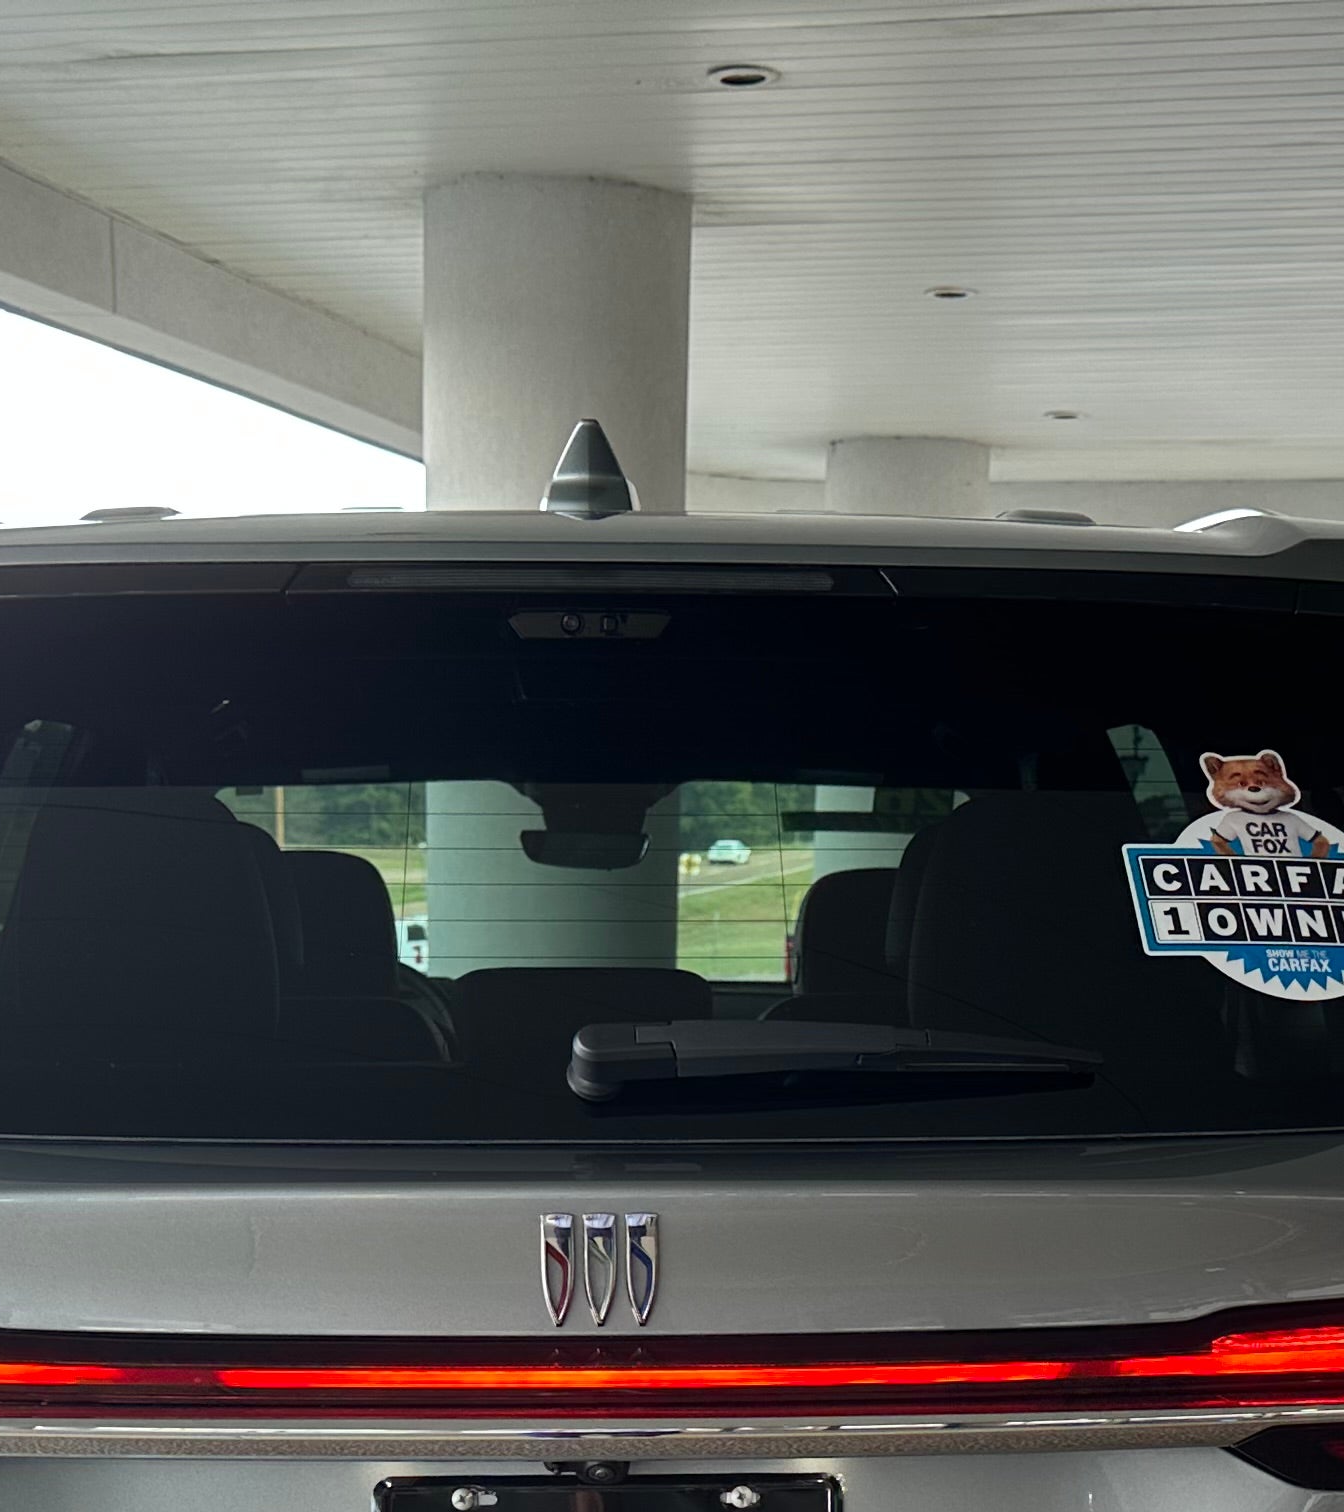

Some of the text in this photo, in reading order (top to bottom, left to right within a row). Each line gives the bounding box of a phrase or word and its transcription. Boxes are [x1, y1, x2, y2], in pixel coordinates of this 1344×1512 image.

[1245, 821, 1288, 839] CAR
[1251, 837, 1292, 854] FOX
[1162, 906, 1190, 936] 1
[1265, 948, 1294, 958] SHOW
[1267, 957, 1332, 973] CARFAX
